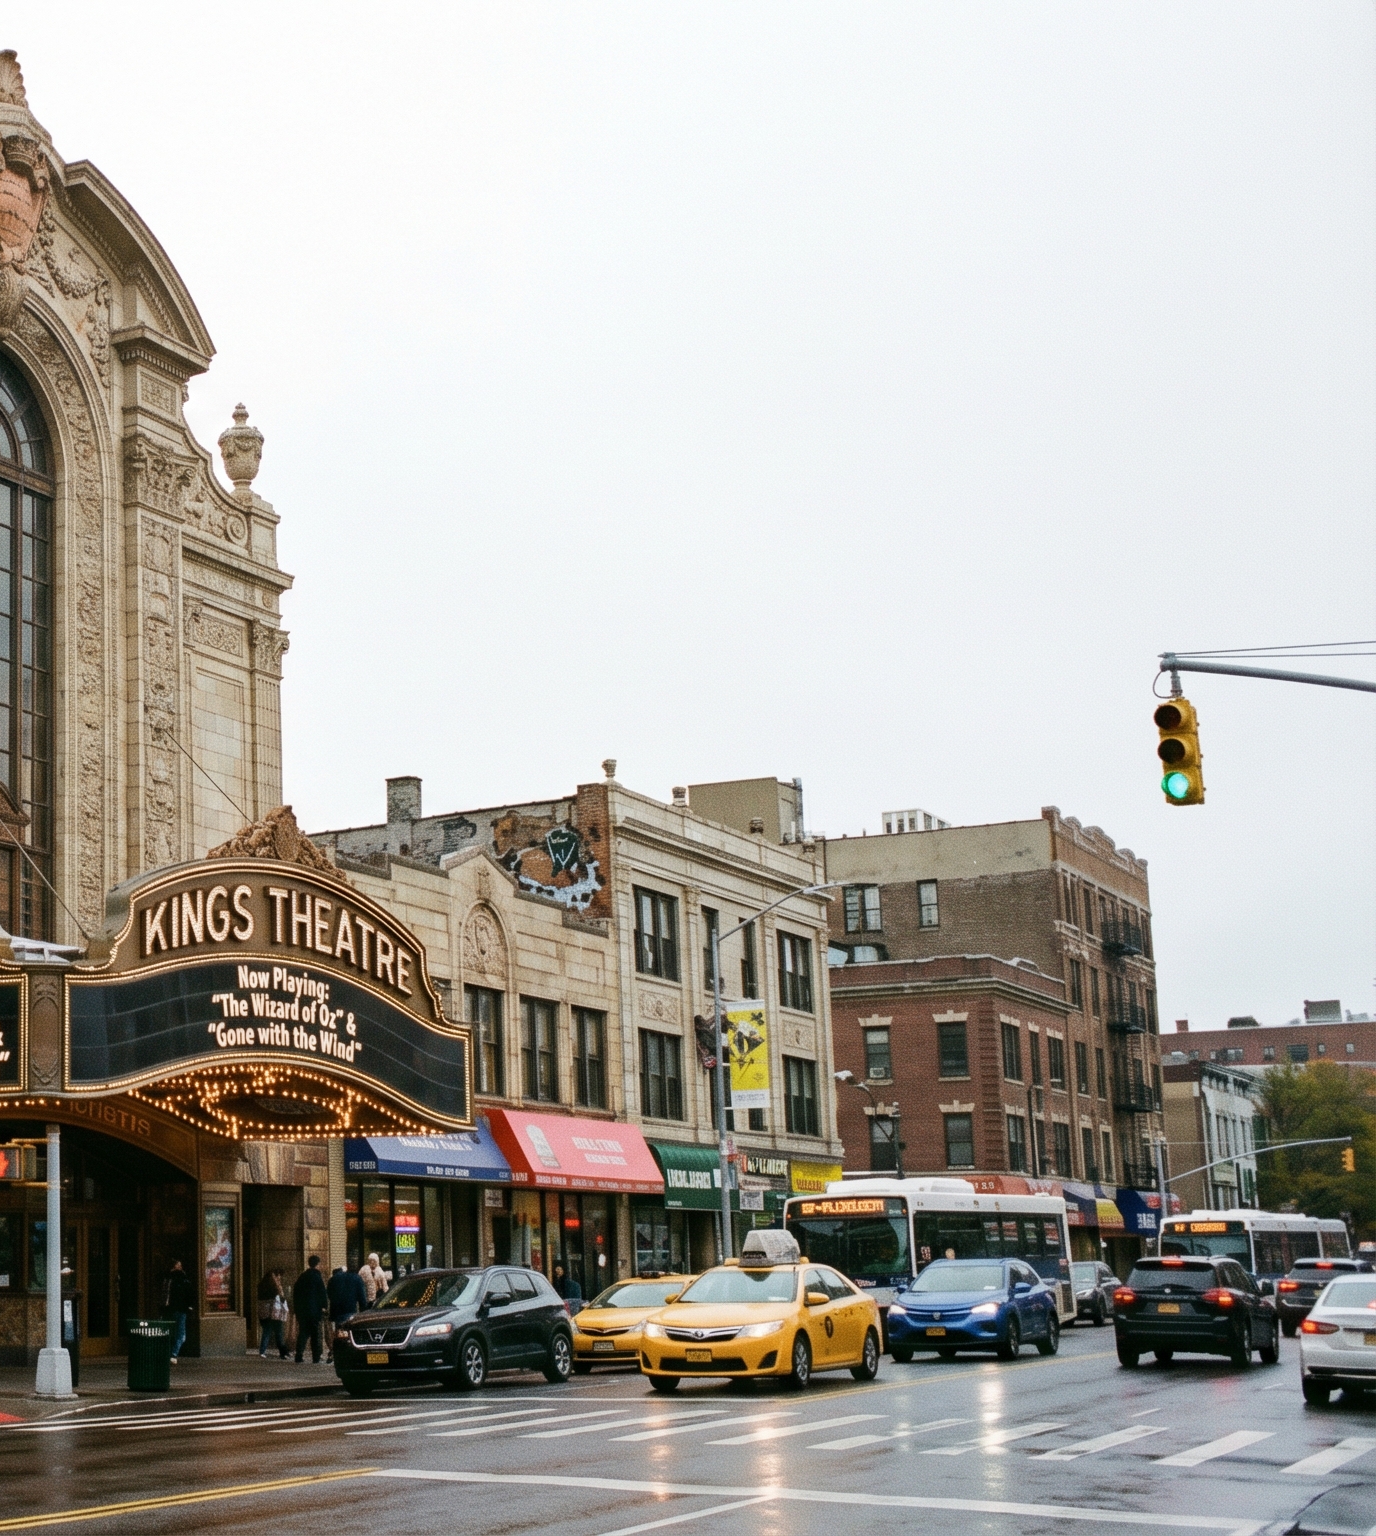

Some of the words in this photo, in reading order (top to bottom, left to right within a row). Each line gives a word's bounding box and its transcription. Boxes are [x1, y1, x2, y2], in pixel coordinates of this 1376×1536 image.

[145, 884, 255, 955] KINGS
[269, 887, 412, 995] THEATRE
[238, 965, 270, 989] Now
[273, 966, 330, 1000] Playing:
[251, 993, 299, 1022] Wizard
[302, 1003, 317, 1024] of
[346, 1012, 357, 1036] &
[257, 1023, 290, 1046] with
[293, 1026, 317, 1052] the
